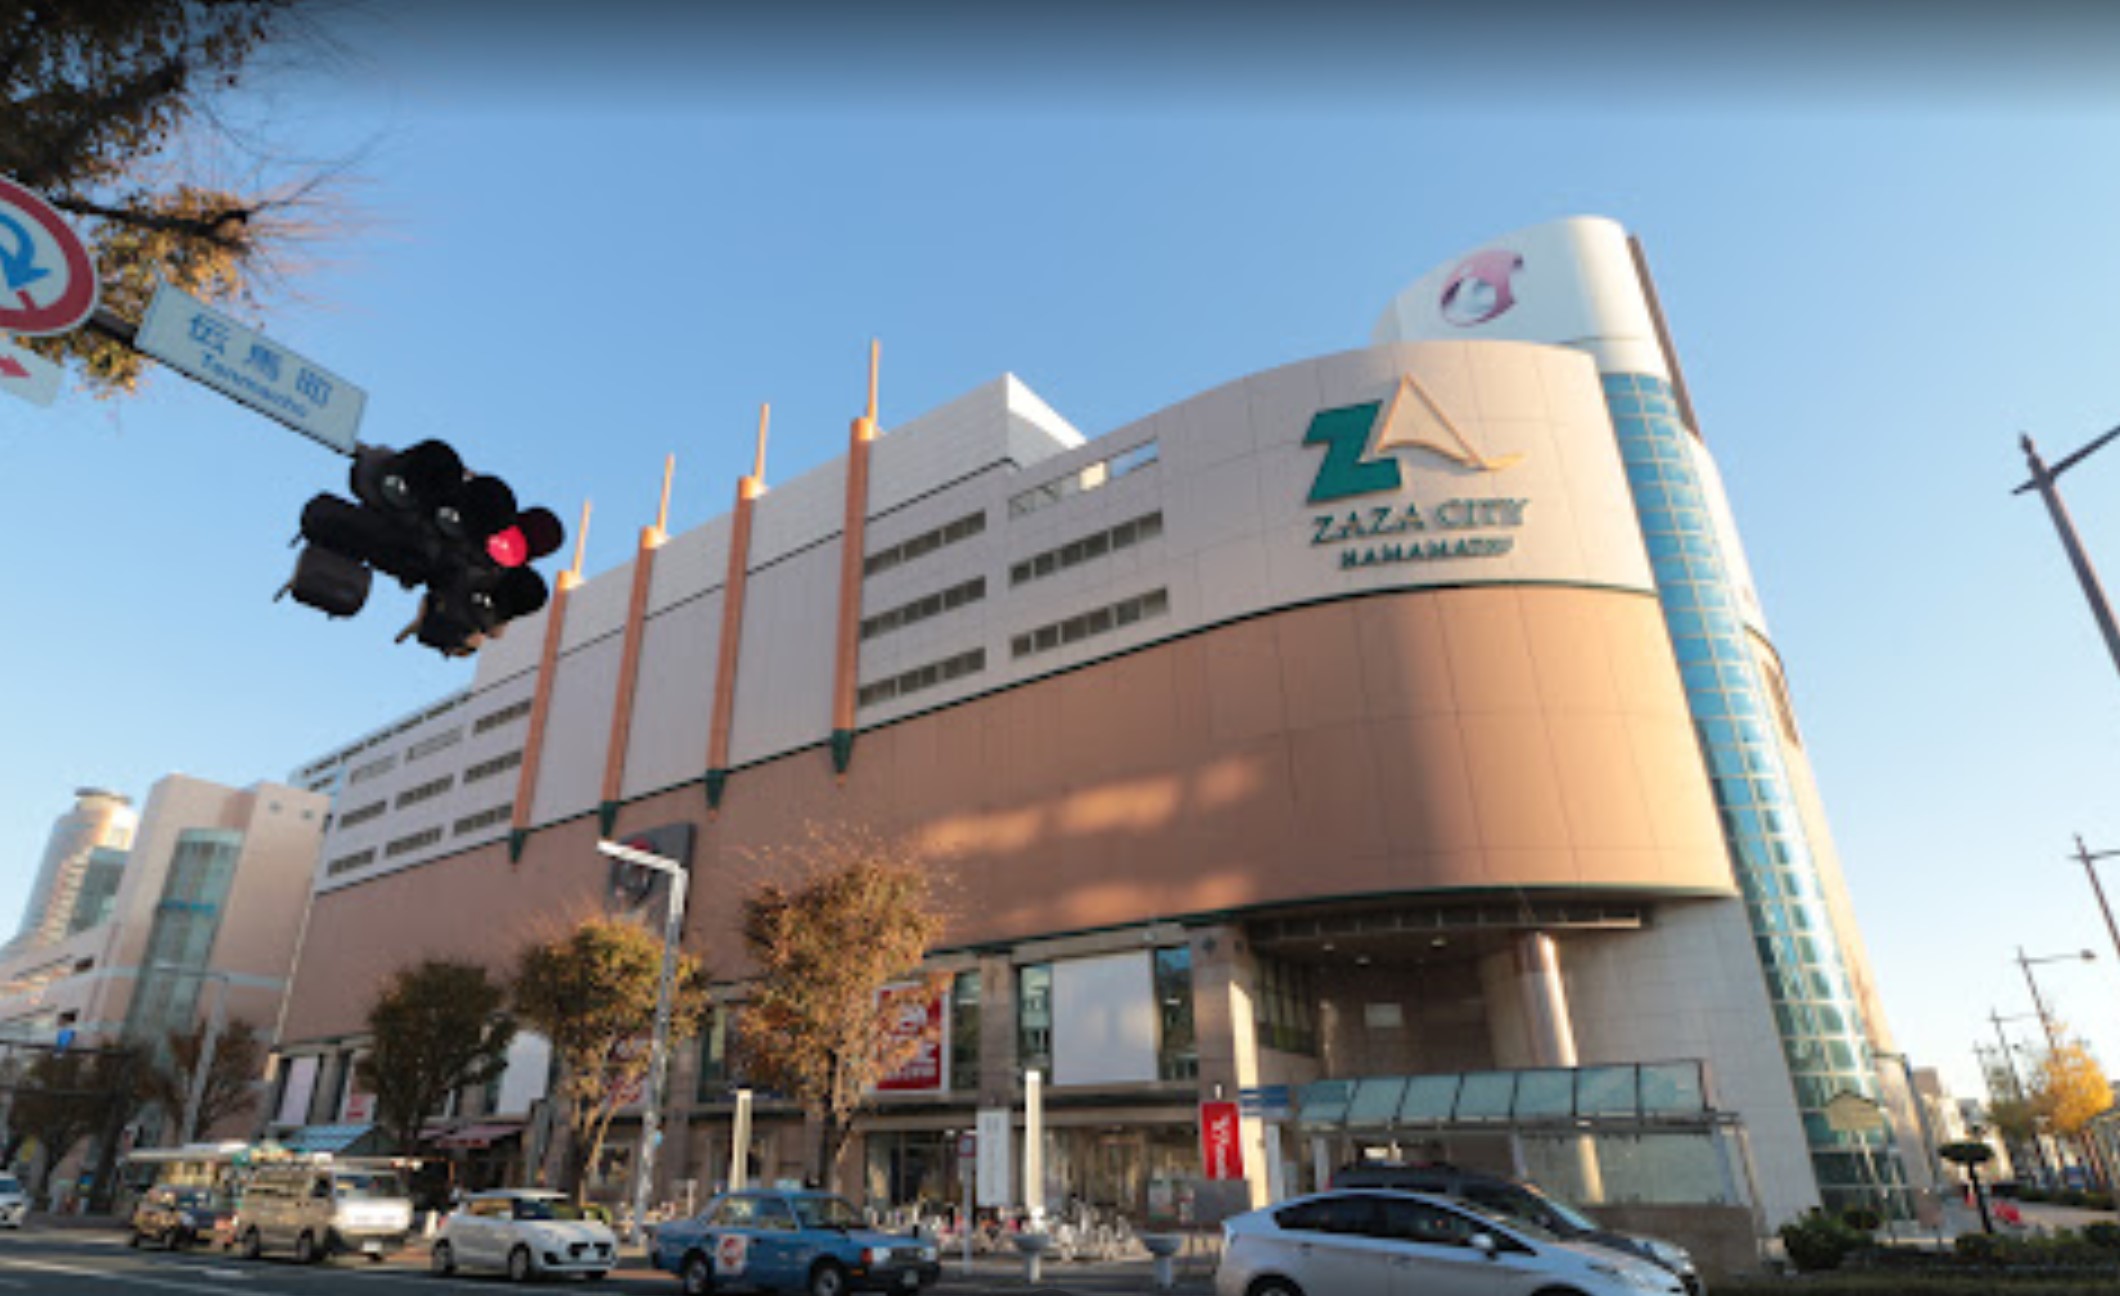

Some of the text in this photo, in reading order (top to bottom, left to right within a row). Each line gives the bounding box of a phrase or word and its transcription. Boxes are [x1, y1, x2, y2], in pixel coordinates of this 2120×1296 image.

[188, 312, 333, 408] 伝馬町
[1312, 498, 1532, 545] ZAZA CITY
